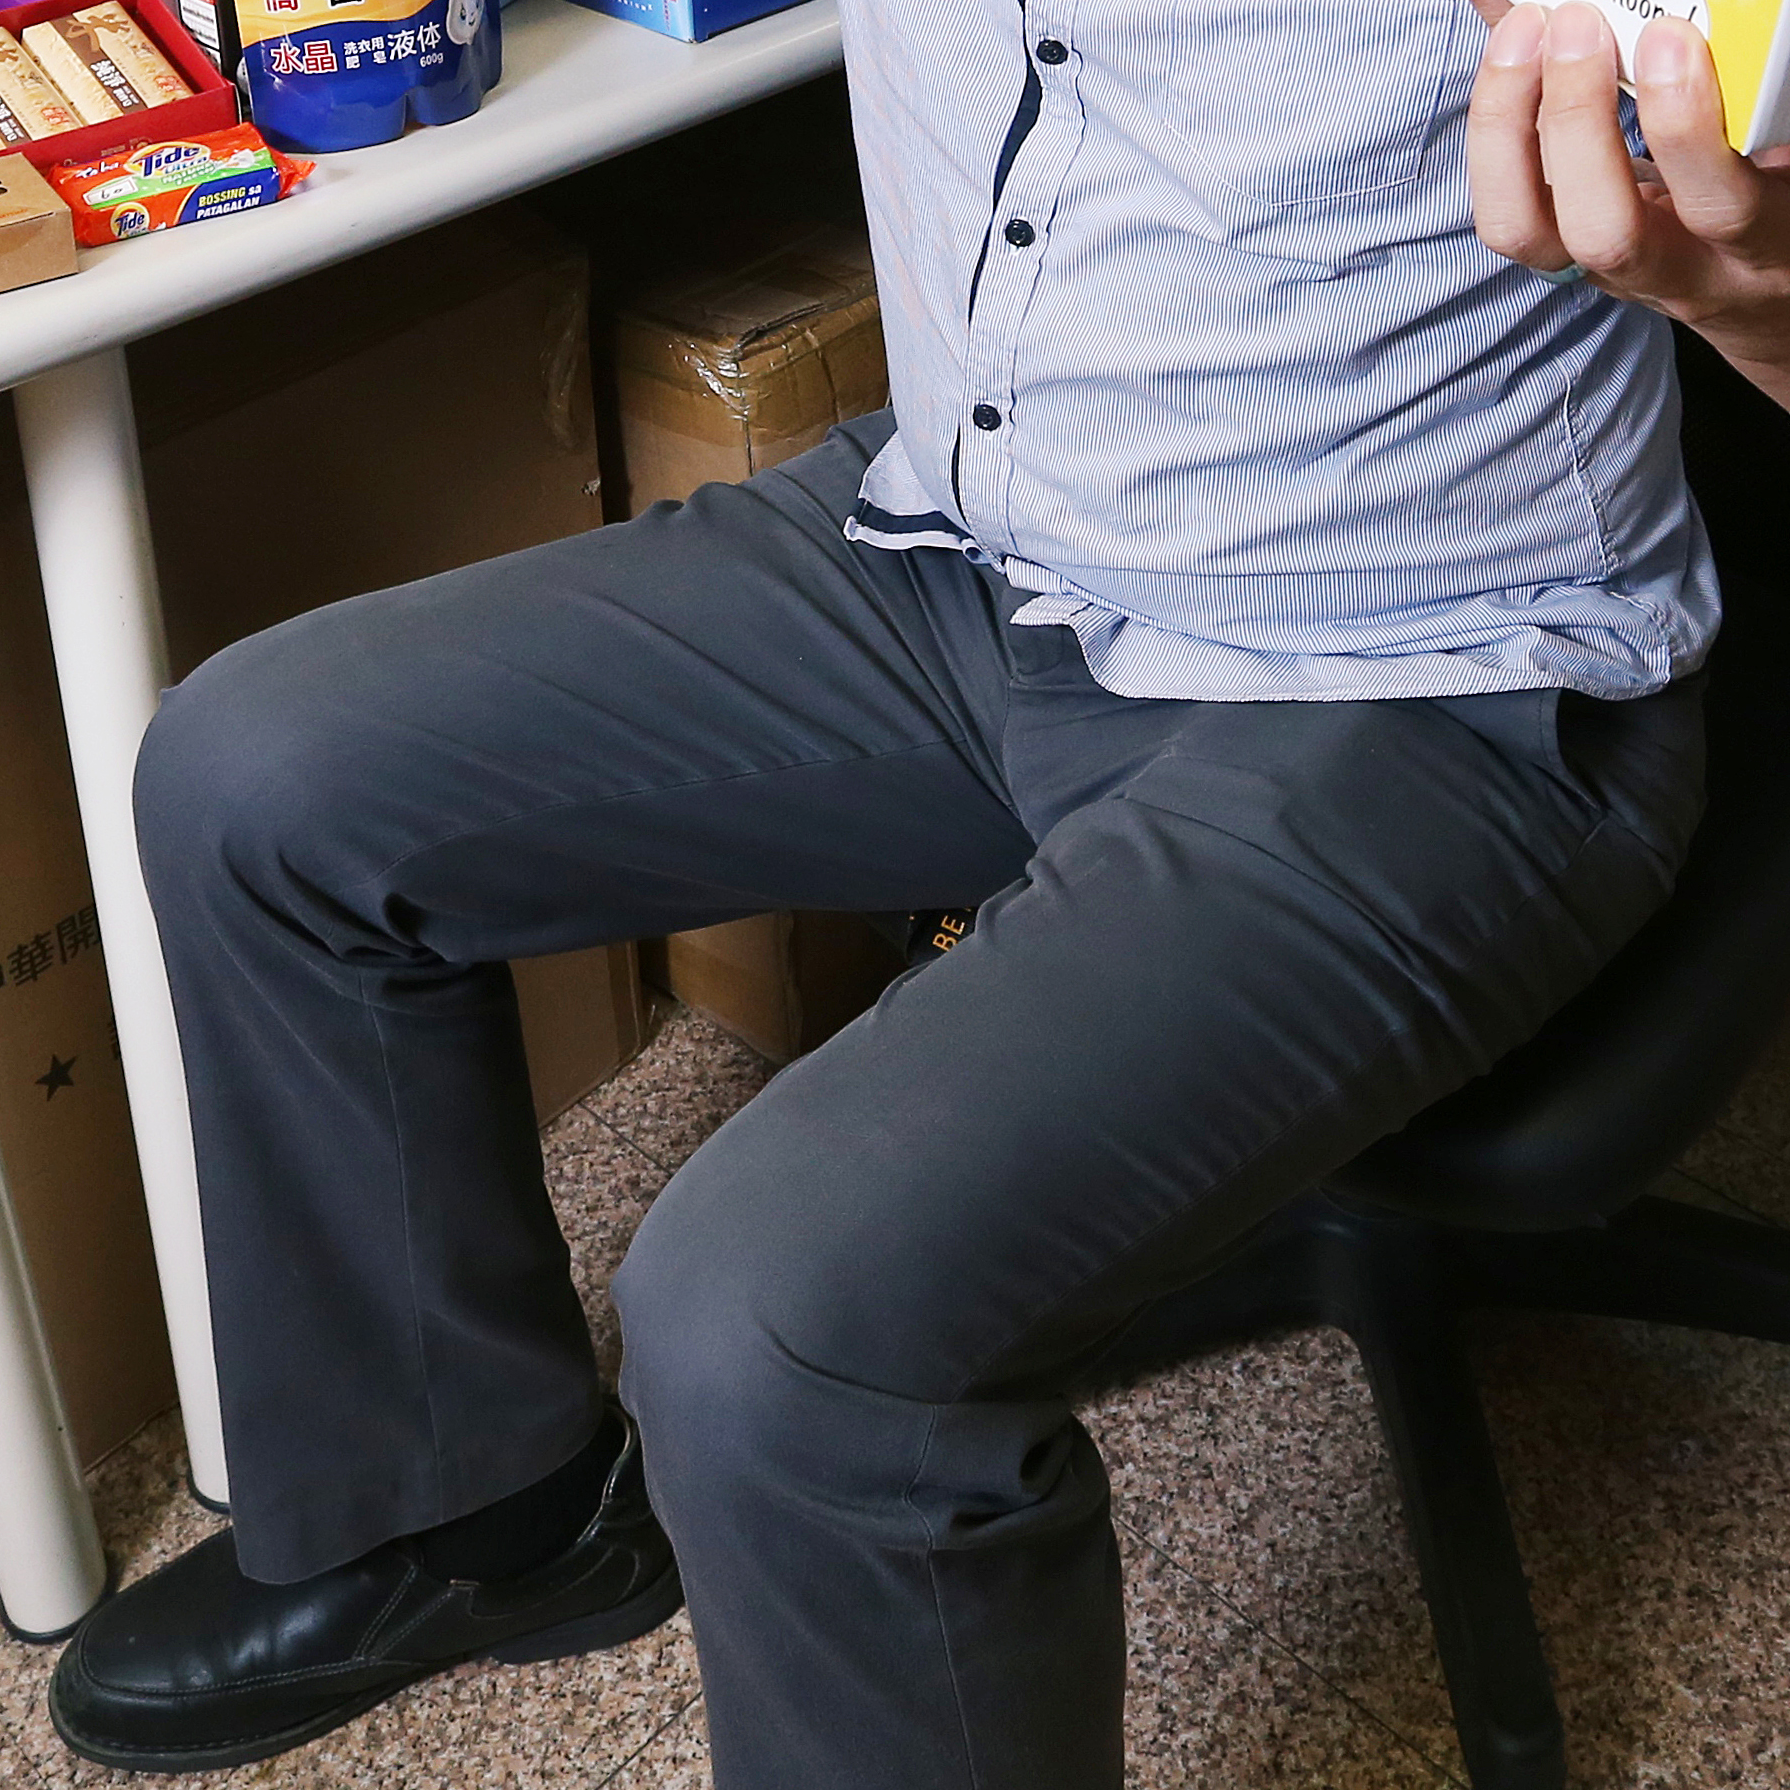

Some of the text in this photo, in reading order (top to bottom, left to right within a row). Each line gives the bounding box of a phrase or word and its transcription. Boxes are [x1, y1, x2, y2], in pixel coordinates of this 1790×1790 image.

[387, 21, 441, 61] 液体
[271, 42, 335, 74] 水晶
[419, 53, 444, 68] 600g
[139, 145, 200, 177] Tide
[196, 196, 260, 219] PATAGALAN
[198, 184, 262, 207] BOSSING sa
[114, 211, 145, 237] Tide
